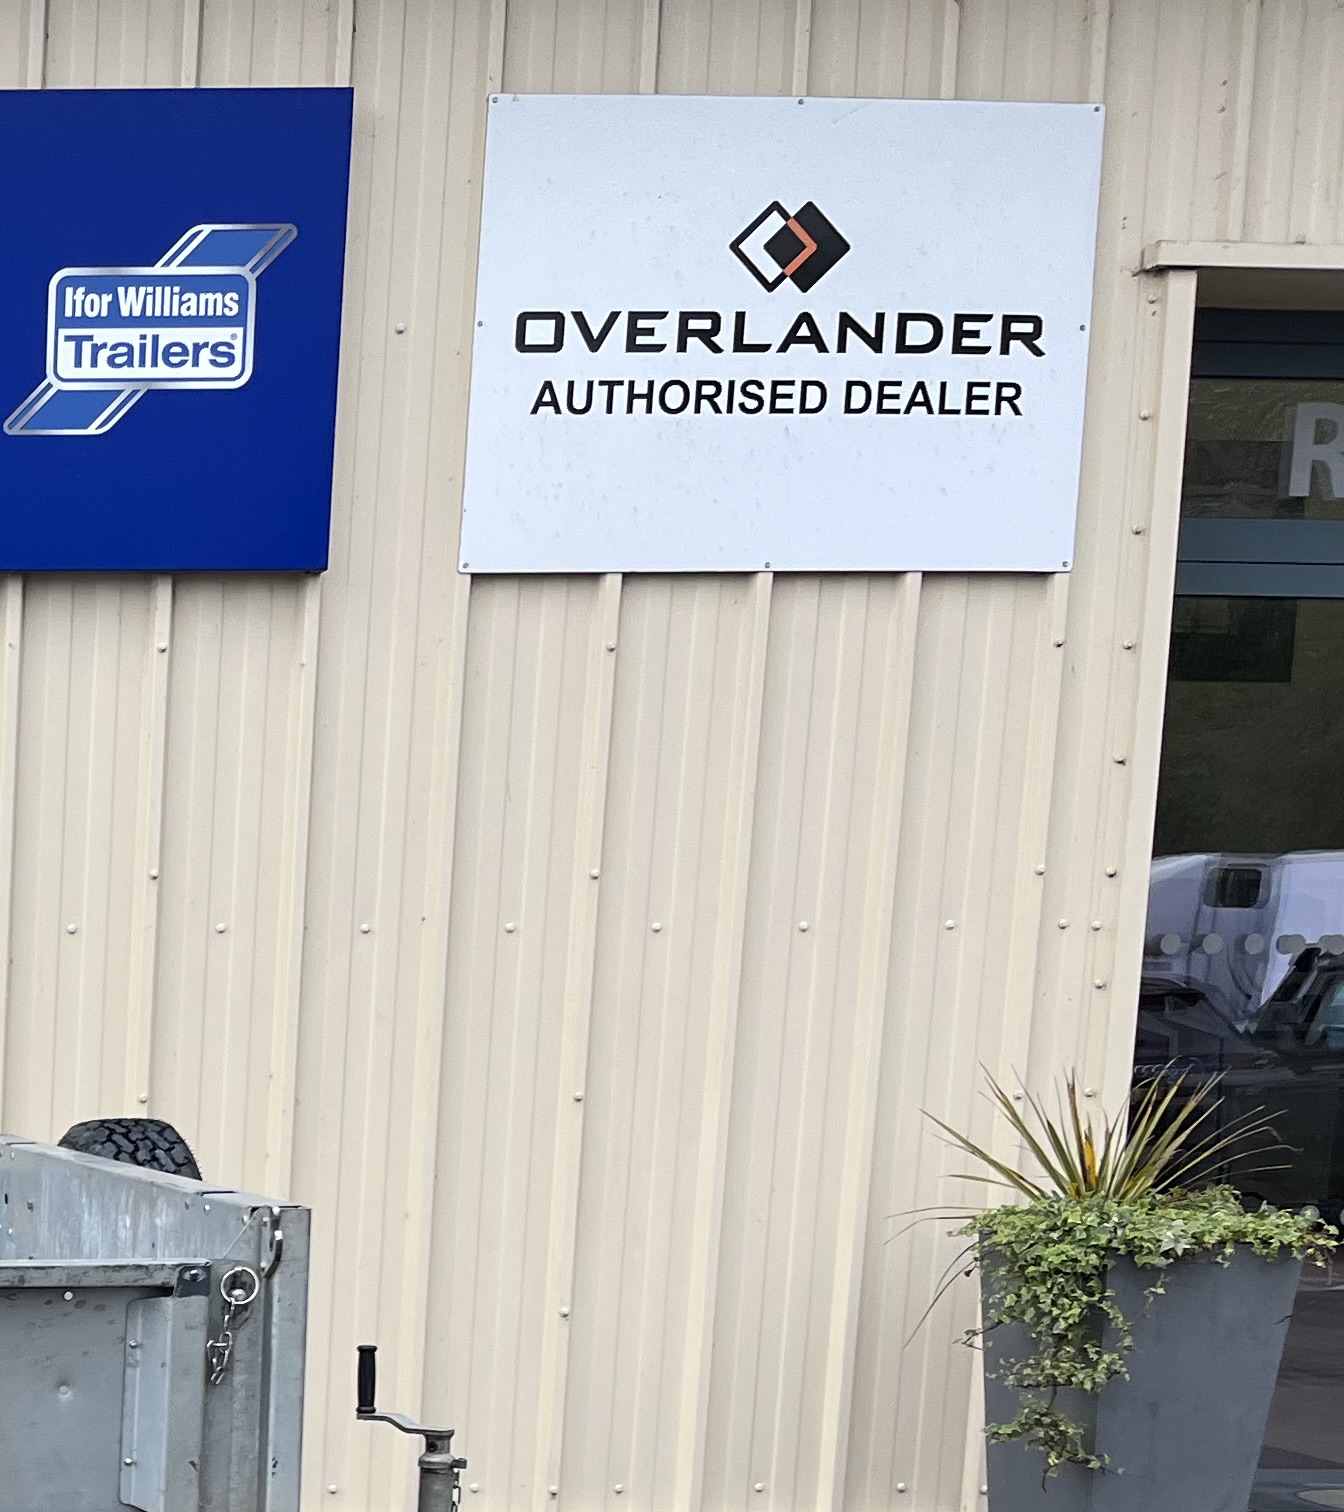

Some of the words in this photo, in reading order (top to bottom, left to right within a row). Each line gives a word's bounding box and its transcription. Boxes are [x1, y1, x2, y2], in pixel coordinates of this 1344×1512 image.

[64, 286, 113, 318] Ifor
[117, 285, 239, 317] Williams
[64, 333, 238, 369] Trailers
[514, 310, 1047, 358] OVERLANDER
[529, 379, 828, 415] AUTHORISED
[843, 379, 1023, 416] DEALER
